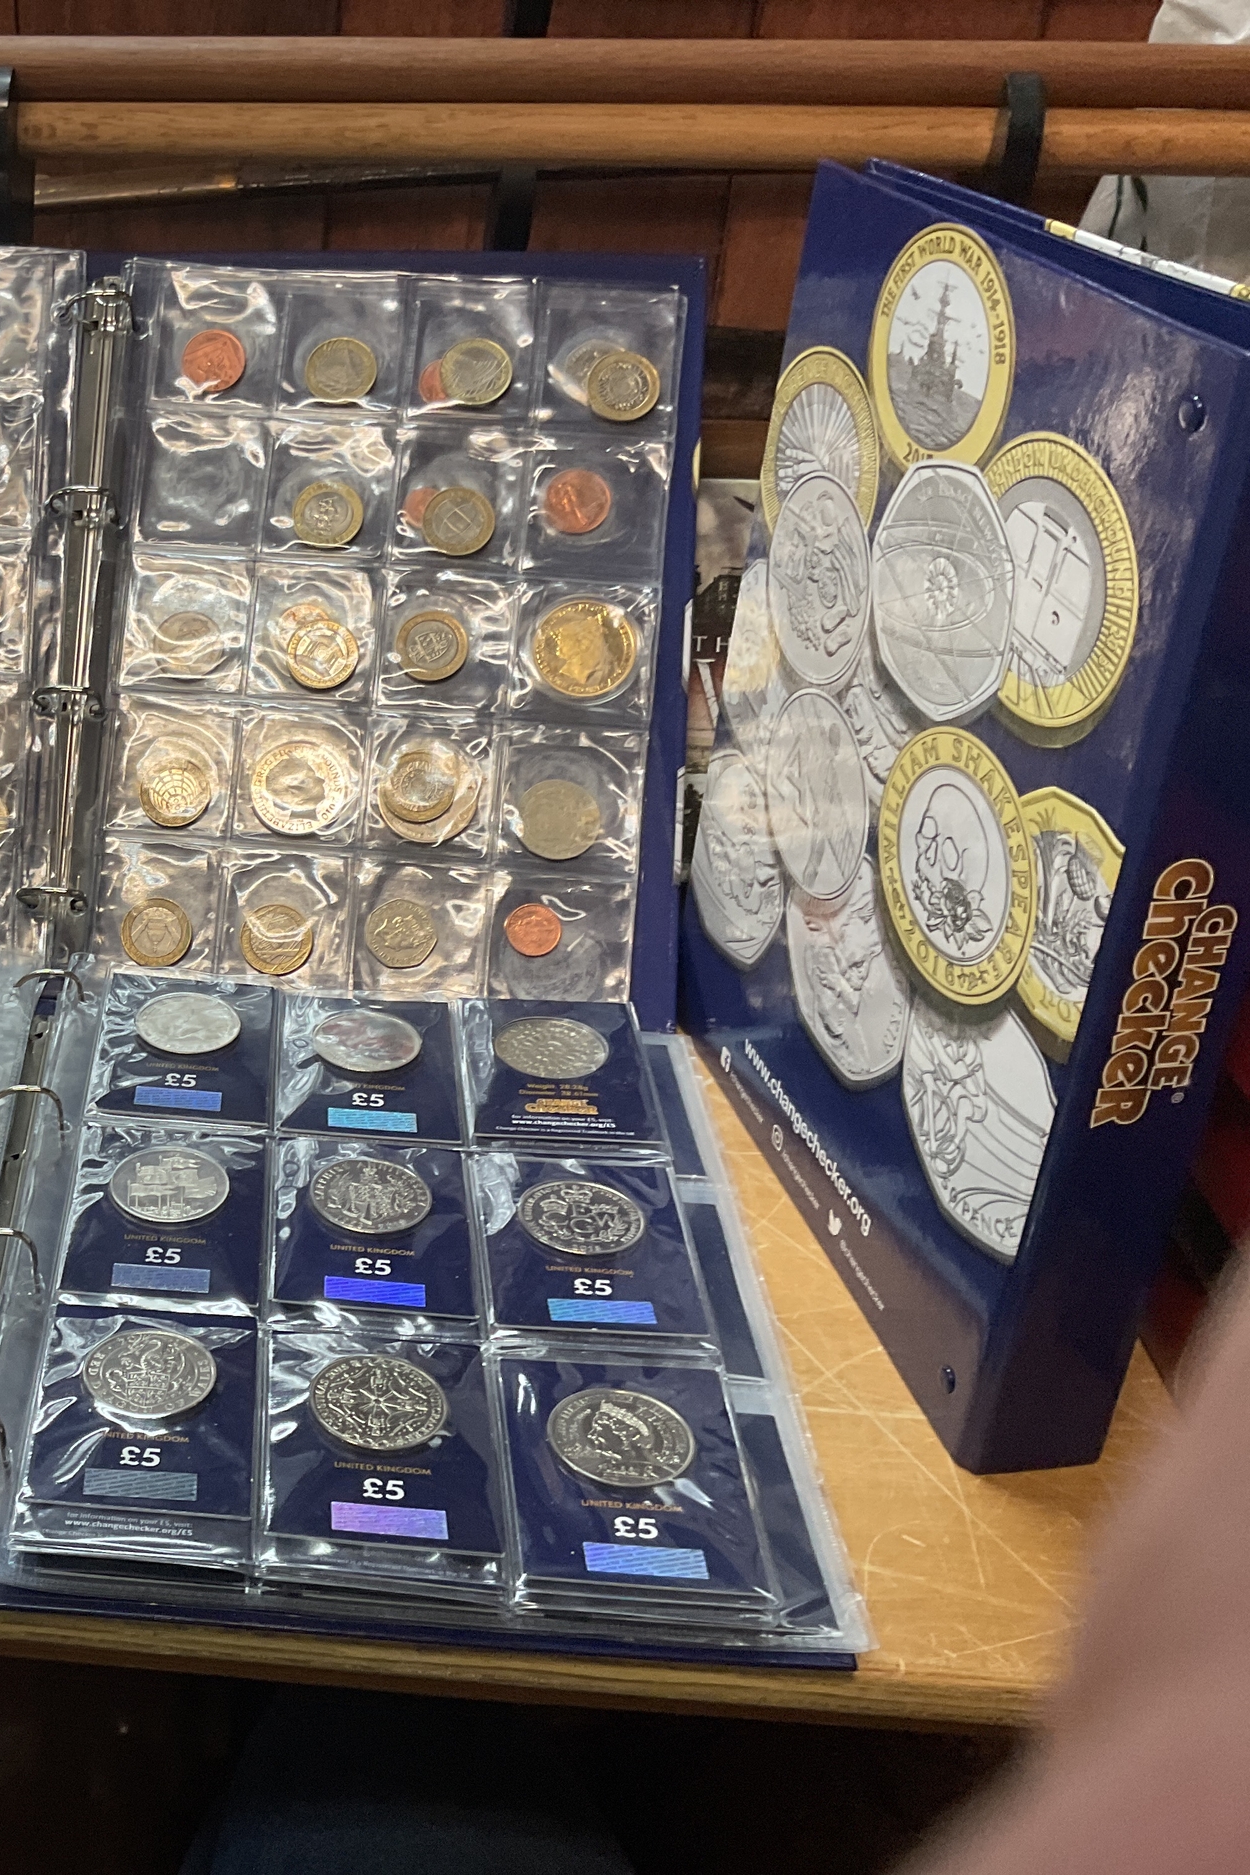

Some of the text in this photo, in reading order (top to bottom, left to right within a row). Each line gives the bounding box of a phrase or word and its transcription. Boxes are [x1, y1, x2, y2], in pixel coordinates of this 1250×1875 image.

[880, 234, 1007, 366] THE FIRST WORLD WAR 1914-1918
[883, 737, 941, 866] WILLIAM
[950, 737, 1029, 981] SHAKESPEARE
[1148, 904, 1238, 1090] CHANGE
[164, 1073, 197, 1088] £5
[351, 1092, 385, 1108] £5
[744, 1038, 871, 1237] www.changechecker.org
[124, 1234, 207, 1246] UNITED KINGDOM
[145, 1247, 181, 1265] £5
[330, 1243, 415, 1256] UNITED KINGDOM
[354, 1257, 392, 1276] £5
[545, 1264, 634, 1277] UNITED KINGDOM
[573, 1279, 613, 1296] £5
[101, 1431, 134, 1440] NITED
[119, 1446, 161, 1467] £5
[334, 1461, 432, 1476] UNITED KINGDOM
[362, 1478, 405, 1500] £5
[582, 1499, 683, 1514] UNITED KINGDOM
[64, 1518, 193, 1536] www.changechecker.org/£5
[614, 1517, 658, 1539] £5
